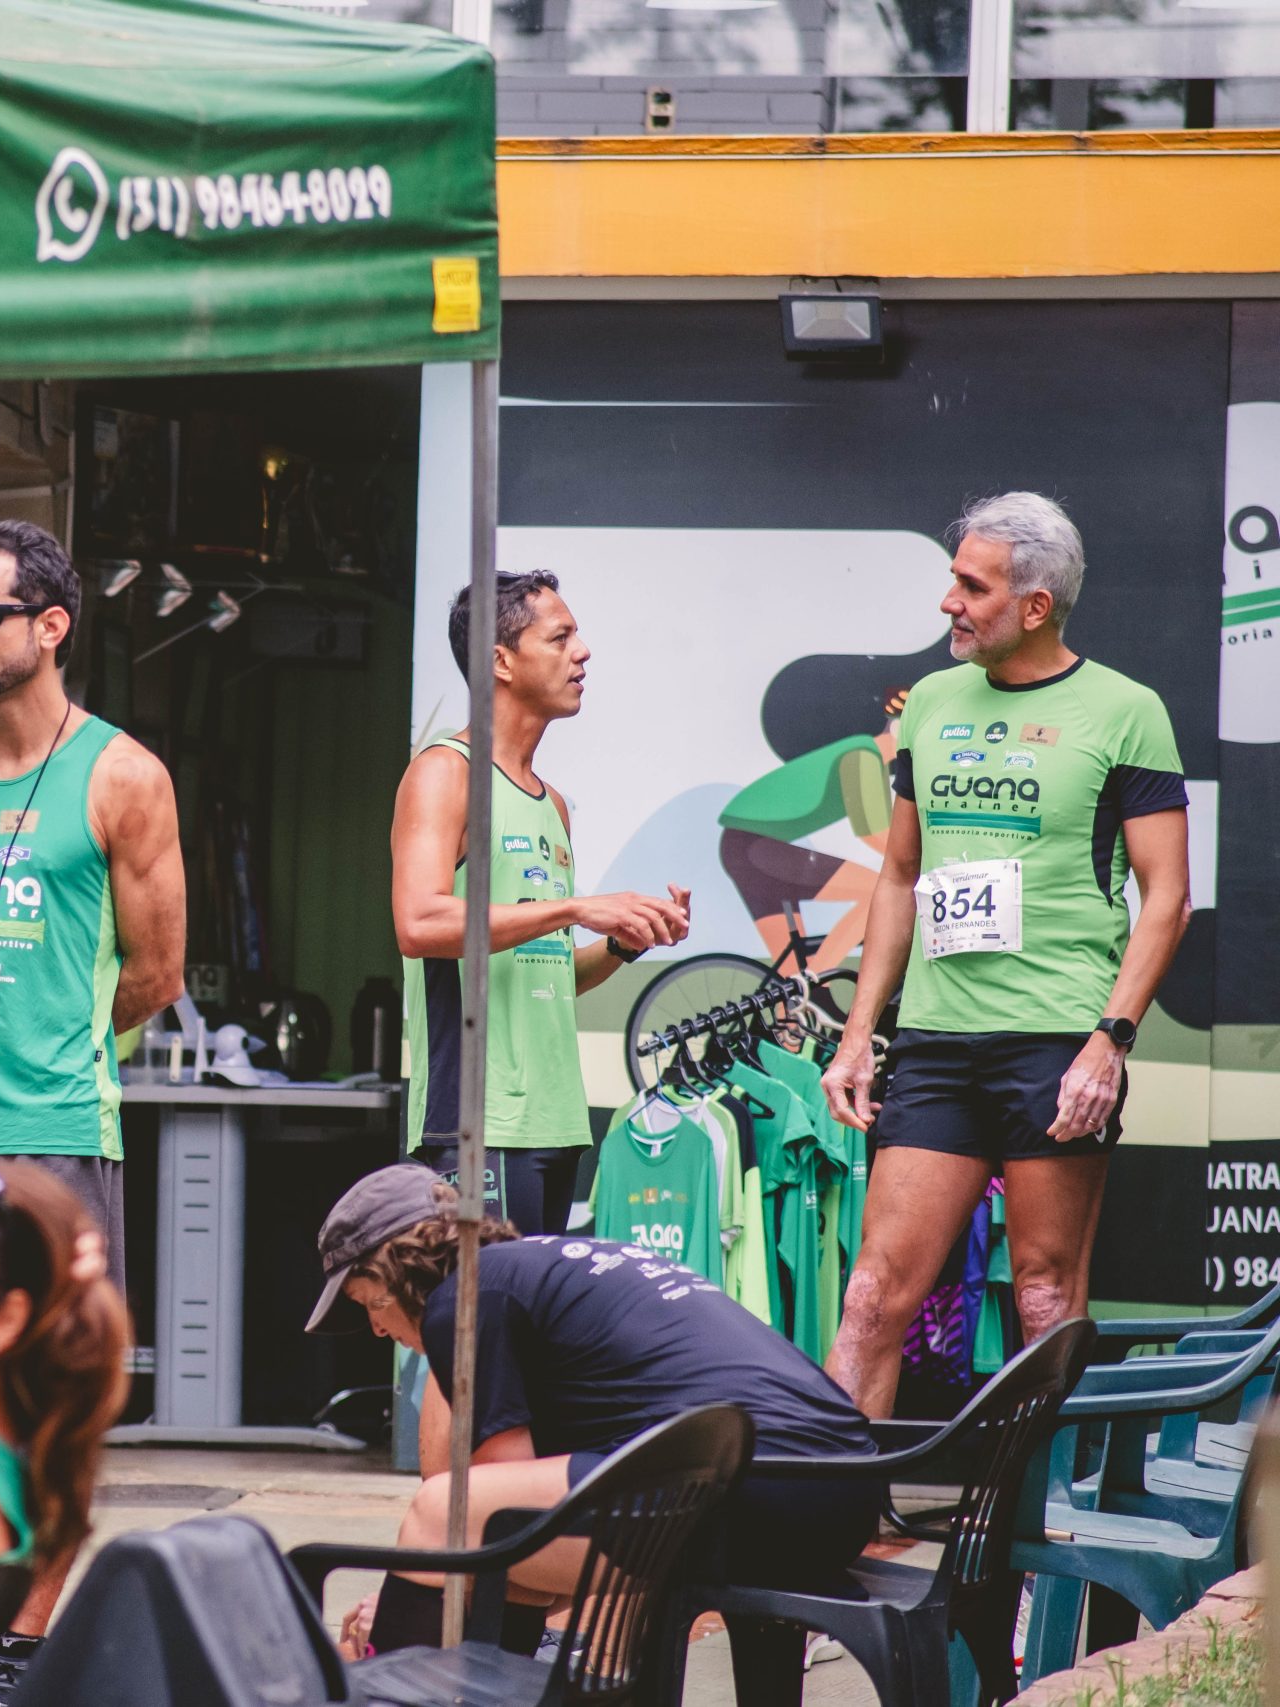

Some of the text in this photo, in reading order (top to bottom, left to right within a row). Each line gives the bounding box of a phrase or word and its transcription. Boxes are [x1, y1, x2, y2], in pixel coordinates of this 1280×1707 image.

[115, 164, 393, 240] (31) 98464-8029
[930, 800, 1037, 814] trainer
[932, 884, 996, 923] 854
[951, 919, 997, 929] FERNANDES
